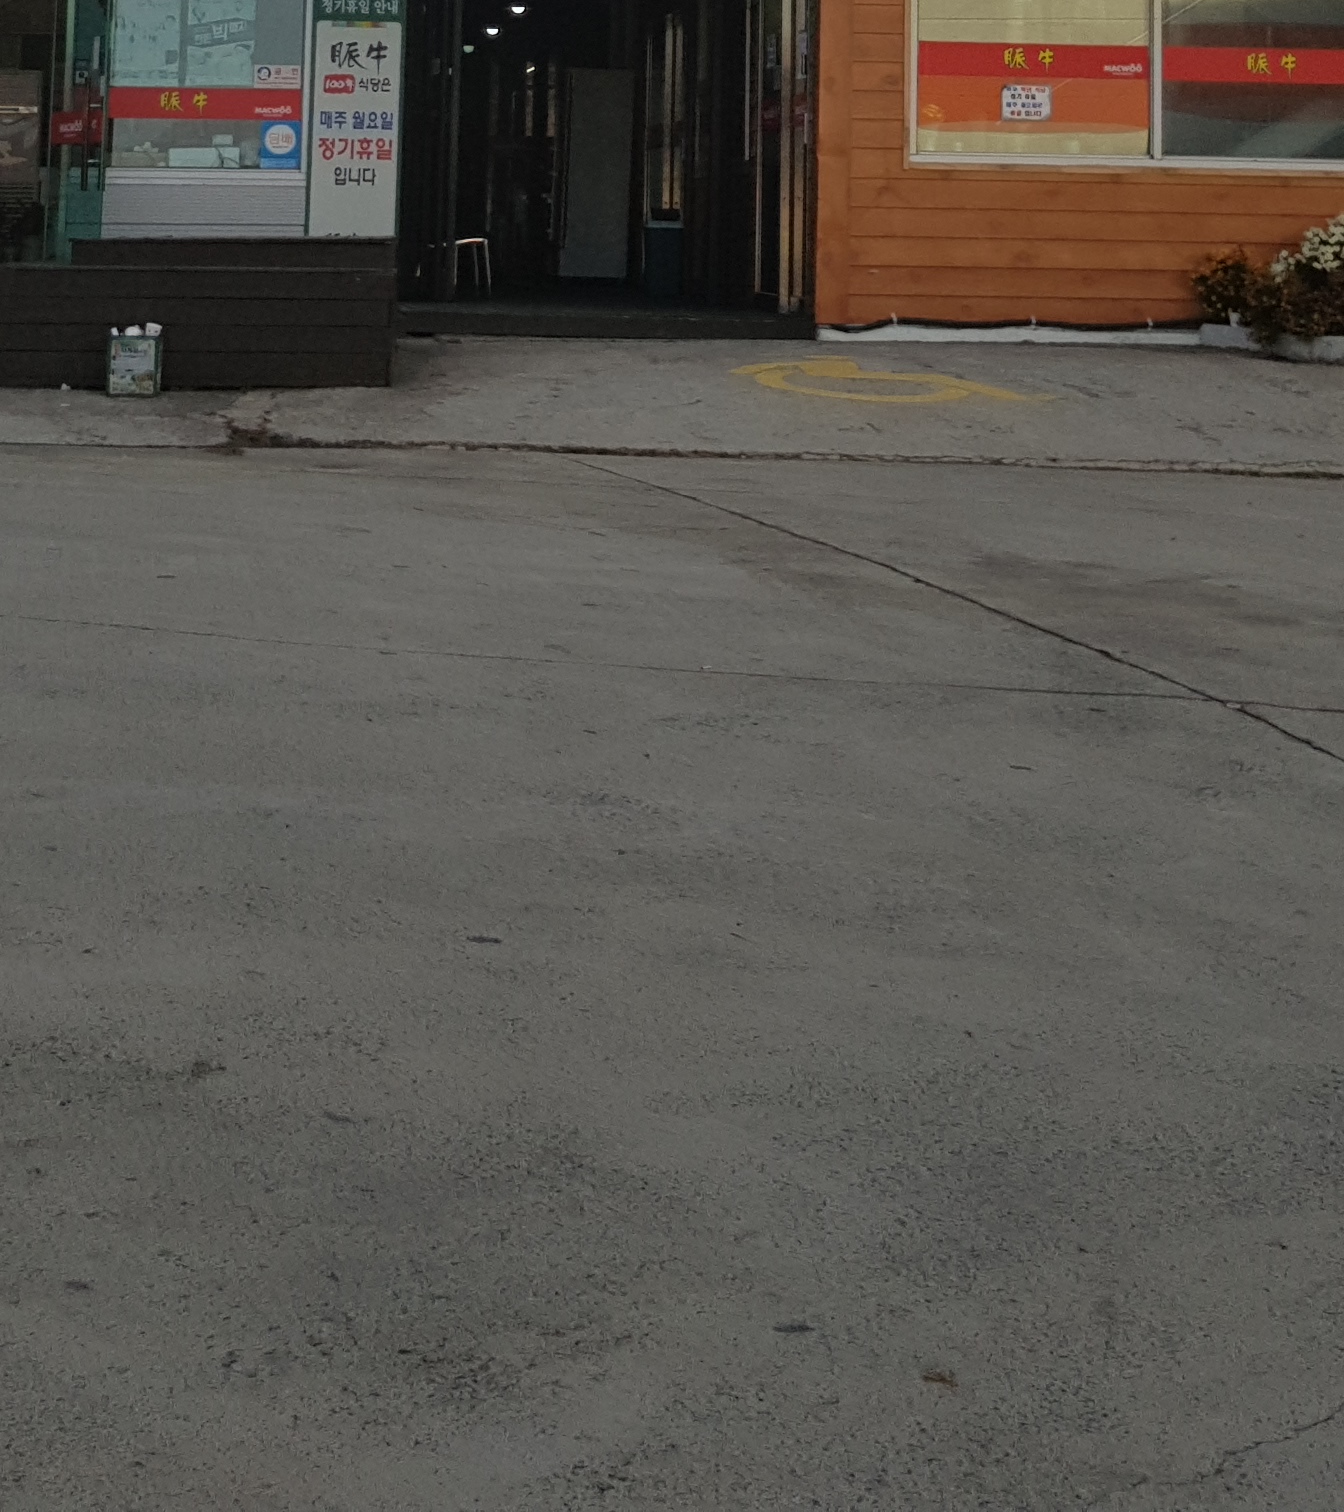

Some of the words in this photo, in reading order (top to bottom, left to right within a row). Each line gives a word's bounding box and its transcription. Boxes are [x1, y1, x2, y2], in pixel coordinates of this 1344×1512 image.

[374, 0, 399, 15] 안내
[358, 77, 392, 93] 식당은
[319, 110, 347, 130] 매주
[352, 110, 394, 131] 월요일
[318, 137, 393, 162] 정기휴일
[334, 166, 377, 187] 입니다
